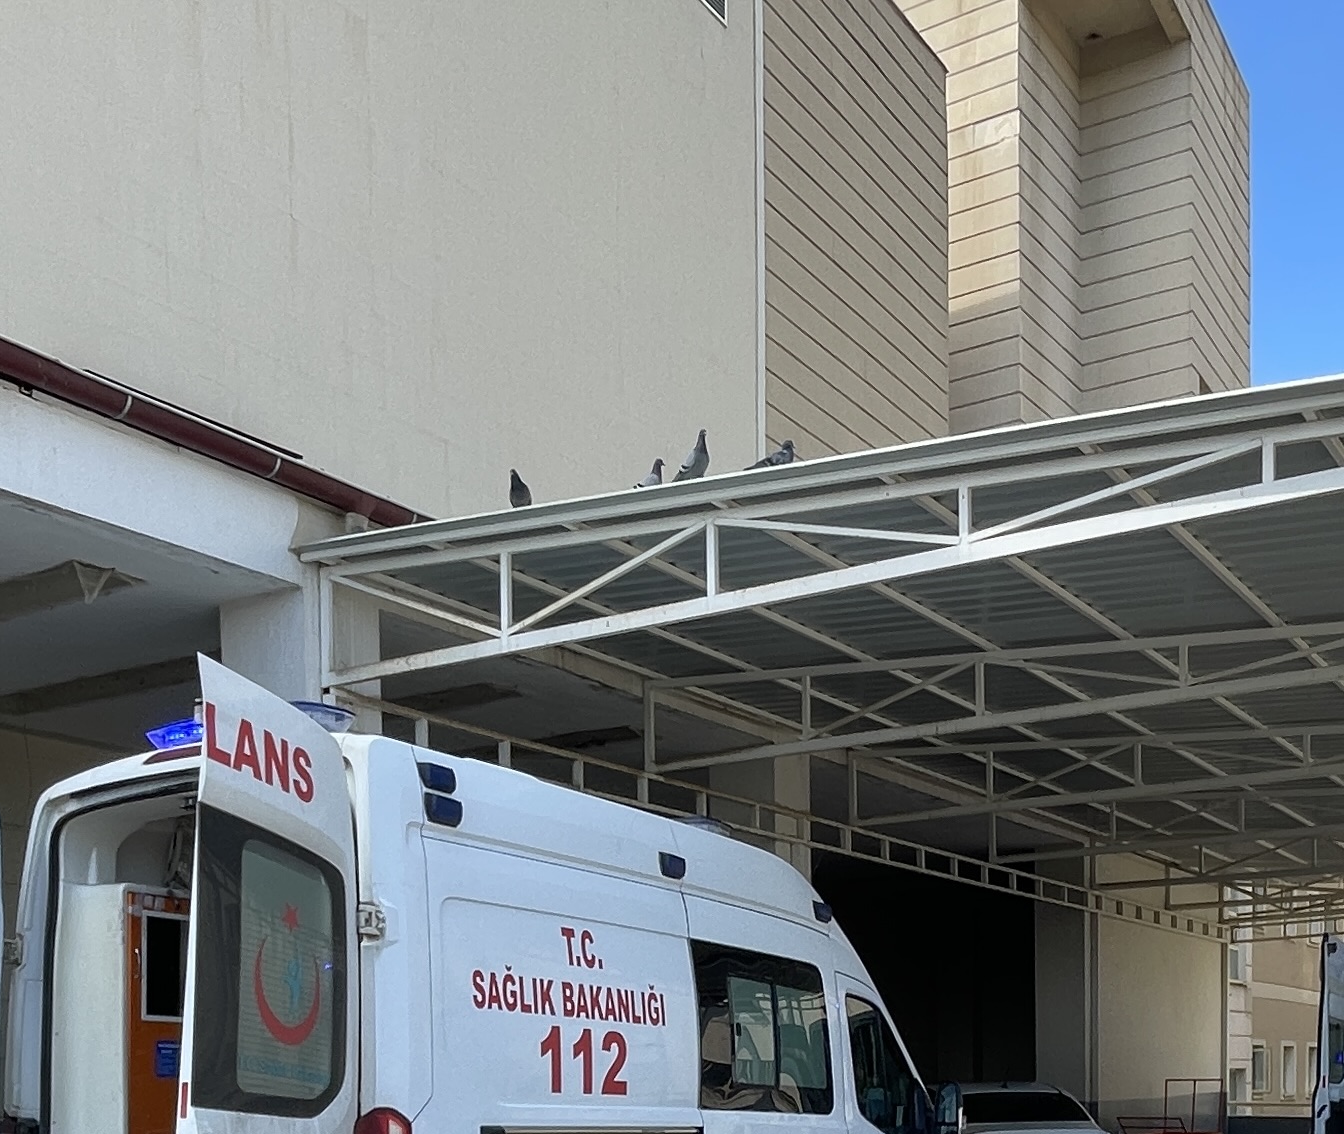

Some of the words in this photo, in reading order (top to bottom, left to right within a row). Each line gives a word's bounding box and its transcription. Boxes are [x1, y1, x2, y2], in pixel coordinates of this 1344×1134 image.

[205, 701, 314, 803] LANS
[560, 926, 604, 970] T.C.
[472, 964, 556, 1016] SAĞLIK
[561, 981, 667, 1027] BAKANLIĞI
[540, 1025, 628, 1096] 112
